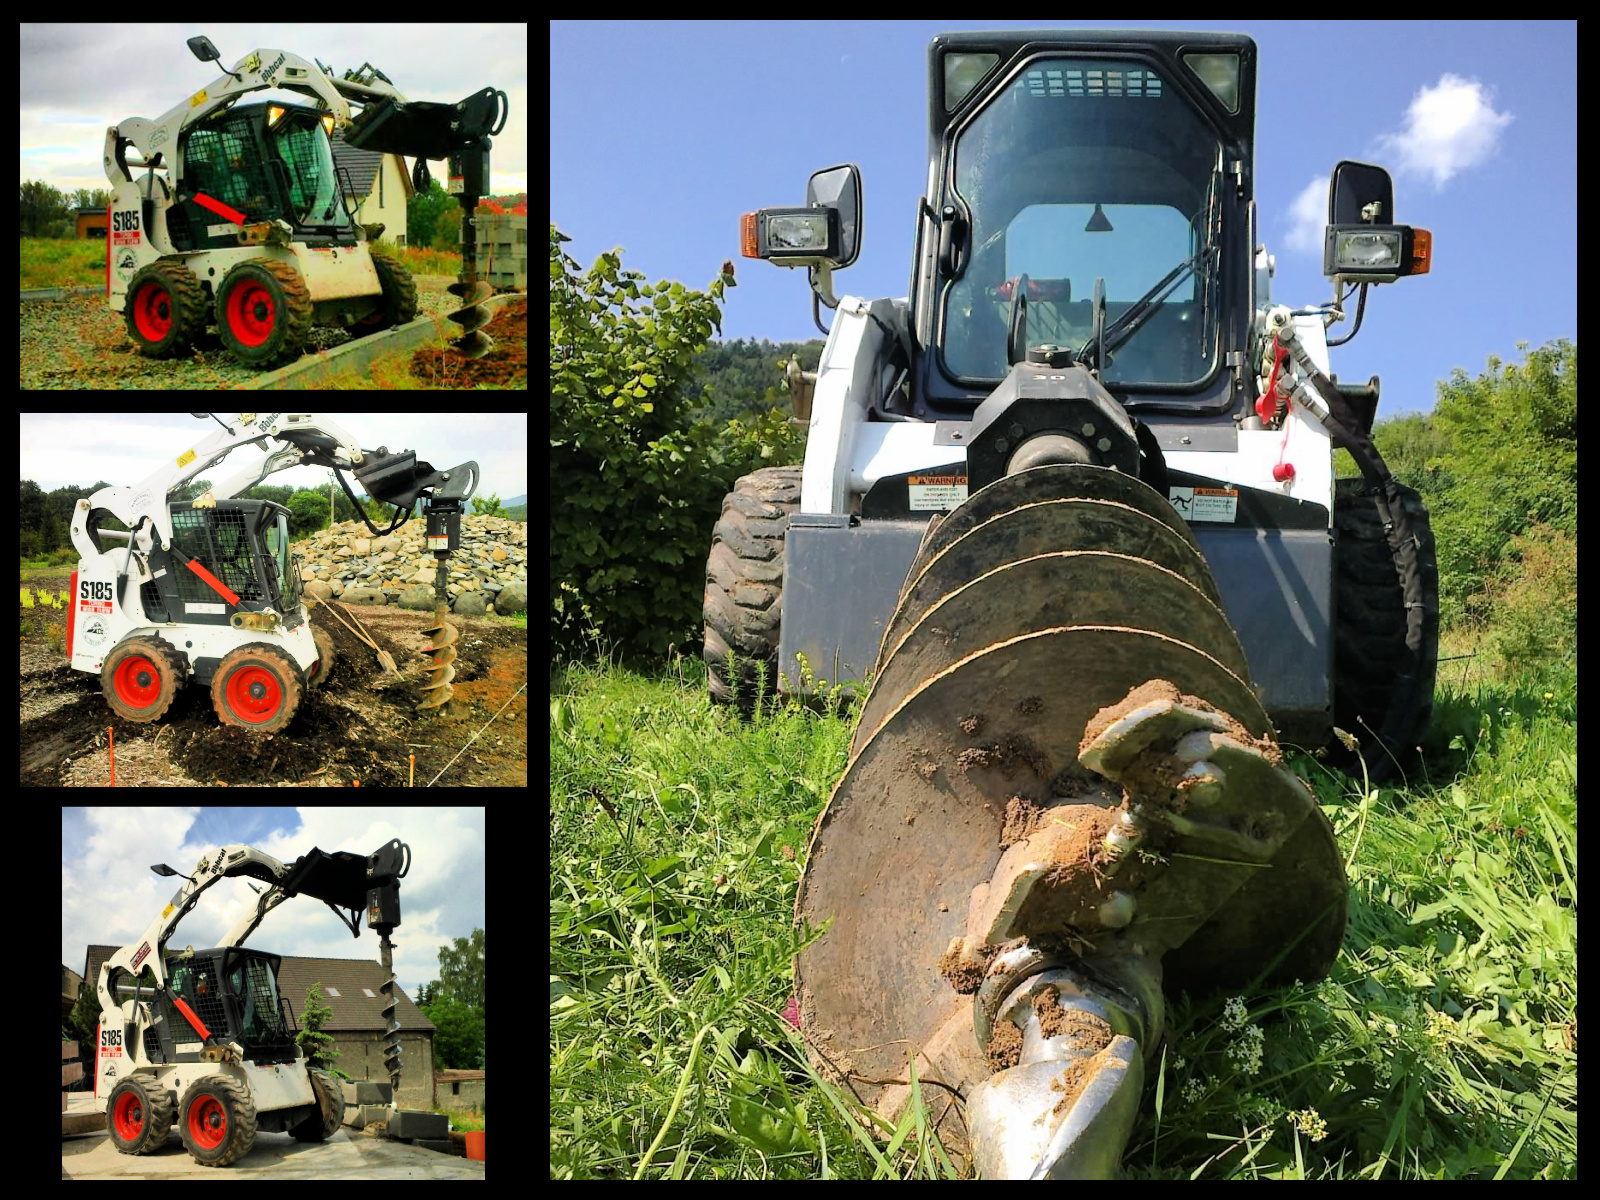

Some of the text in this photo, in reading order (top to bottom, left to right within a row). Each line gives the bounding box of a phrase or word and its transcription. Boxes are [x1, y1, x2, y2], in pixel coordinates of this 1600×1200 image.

[261, 53, 286, 83] Bobcat
[113, 210, 140, 231] S185
[259, 413, 280, 432] Bobc
[928, 475, 967, 485] WARNING
[80, 580, 113, 601] S185
[211, 848, 227, 875] Bobcat
[101, 1029, 122, 1046] S185
